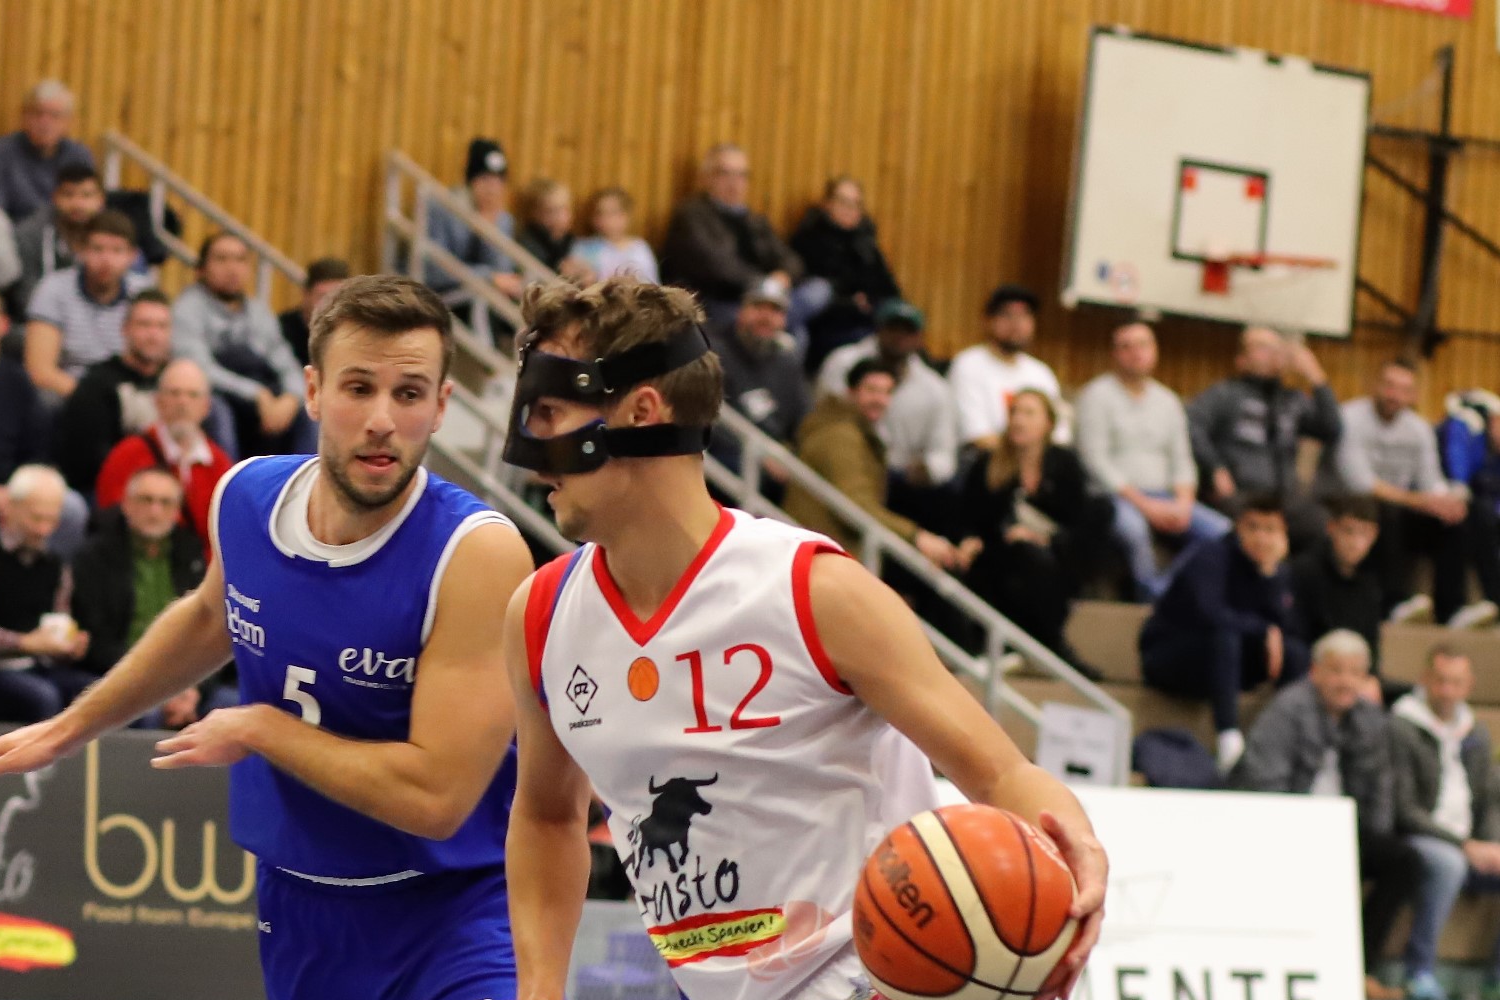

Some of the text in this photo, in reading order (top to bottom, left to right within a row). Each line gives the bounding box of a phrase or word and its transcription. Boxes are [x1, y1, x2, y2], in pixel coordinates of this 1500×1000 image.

[283, 664, 321, 727] 5
[338, 647, 415, 684] eva
[675, 643, 781, 734] 12
